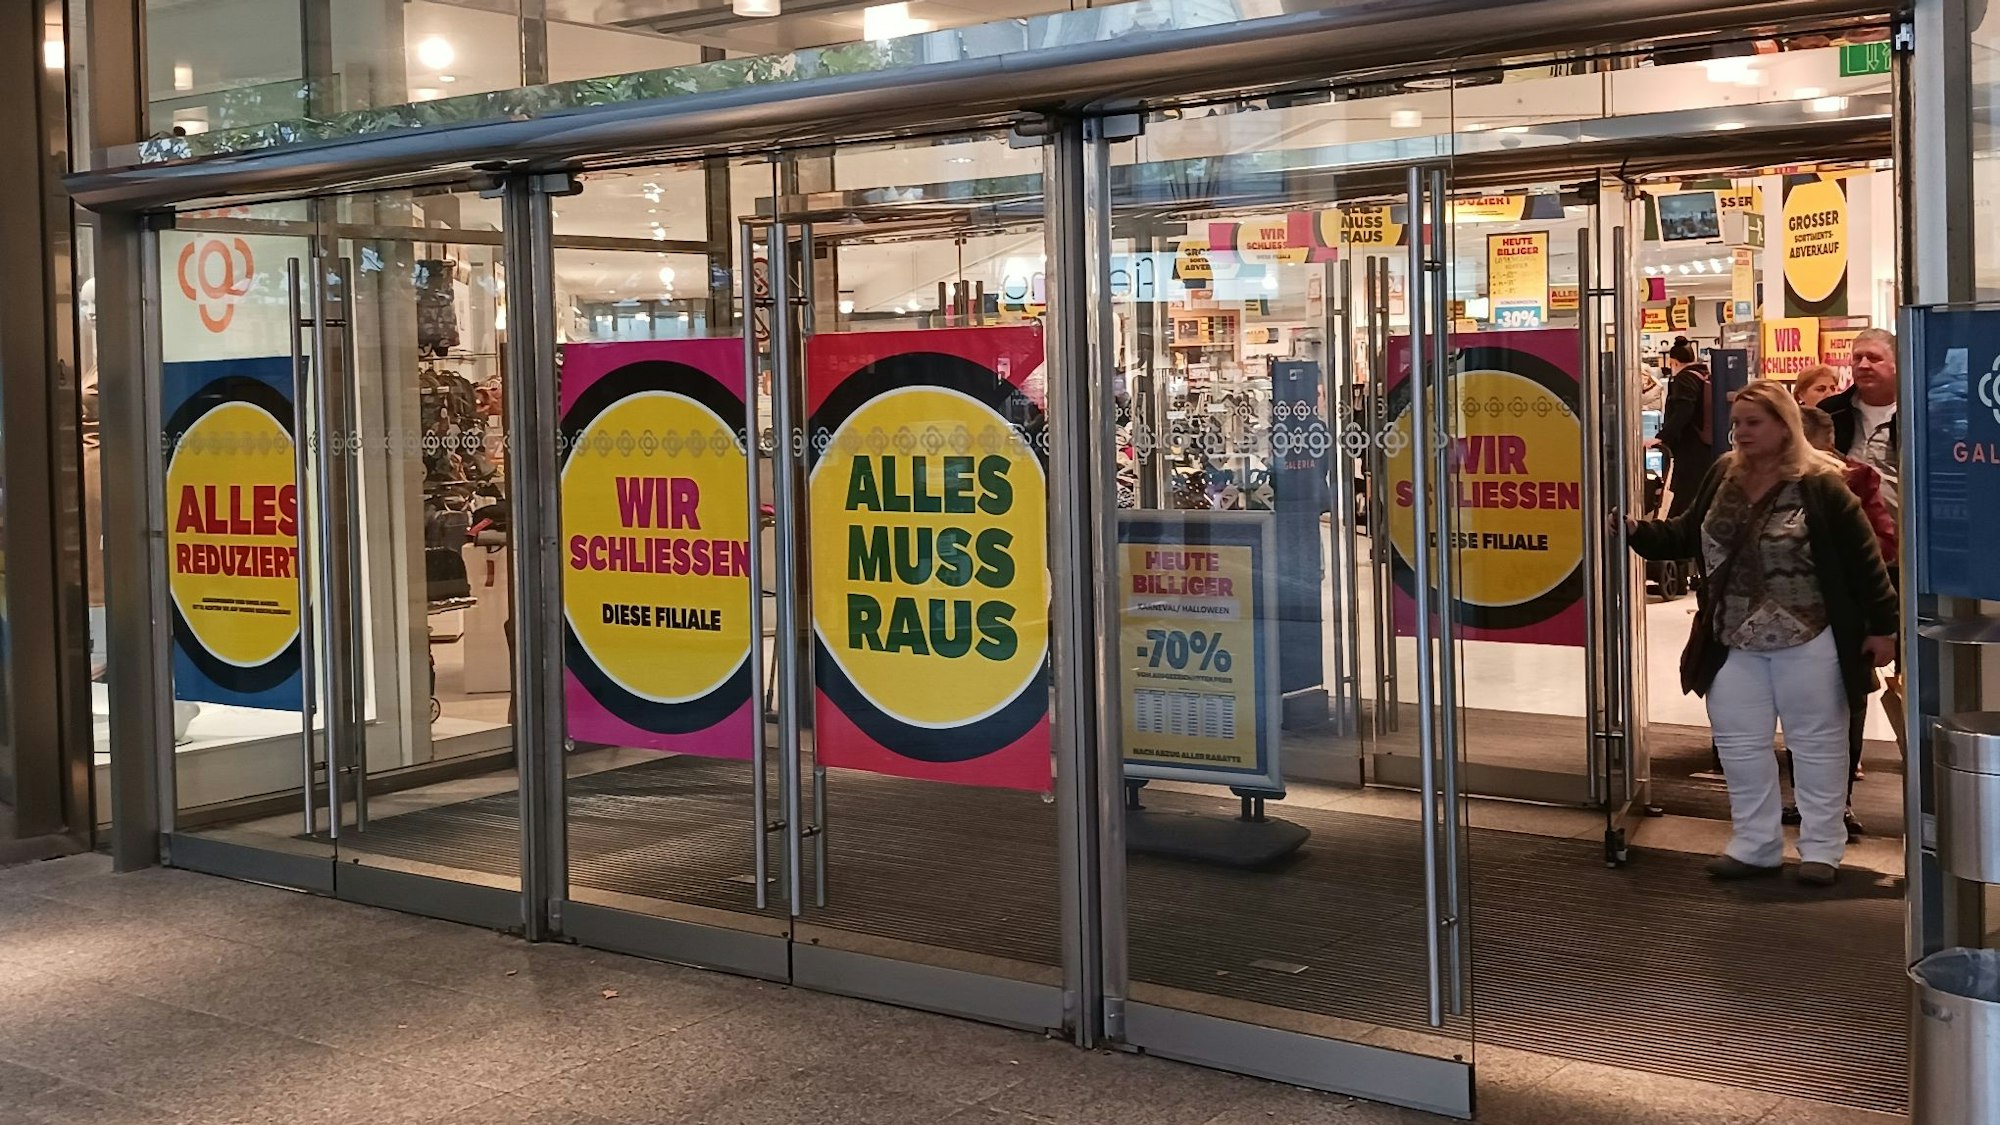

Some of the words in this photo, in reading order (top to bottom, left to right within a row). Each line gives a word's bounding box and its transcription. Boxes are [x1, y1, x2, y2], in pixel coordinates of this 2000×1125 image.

[1341, 216, 1383, 228] MUSS
[1788, 210, 1839, 231] GROSSER
[1259, 228, 1285, 240] WIR
[1341, 231, 1383, 243] RAUS
[1503, 237, 1532, 246] HEUTE
[1497, 247, 1538, 256] BILLIGER
[1789, 242, 1840, 258] ABVERKAUF
[1497, 310, 1539, 328] -30%
[1775, 328, 1802, 352] WIR
[1446, 435, 1528, 475] WIR
[1953, 442, 2000, 464] GAL
[843, 454, 1014, 516] ALLES
[1395, 480, 1580, 510] SLIESSEN
[175, 484, 297, 537] ALLES
[615, 476, 701, 530] WIR
[1429, 532, 1478, 549] DESE
[1483, 534, 1548, 551] FILIALE
[570, 534, 750, 578] SCHLIESSEN
[847, 524, 1016, 589] MUSS
[1145, 551, 1219, 572] HEUTE
[1132, 574, 1234, 597] BILLIGER
[602, 603, 652, 626] DIESE
[655, 606, 721, 631] FILIALE
[1182, 605, 1230, 614] HALLOWEEN
[846, 593, 1019, 662] RAUS
[1136, 629, 1232, 673] -70%
